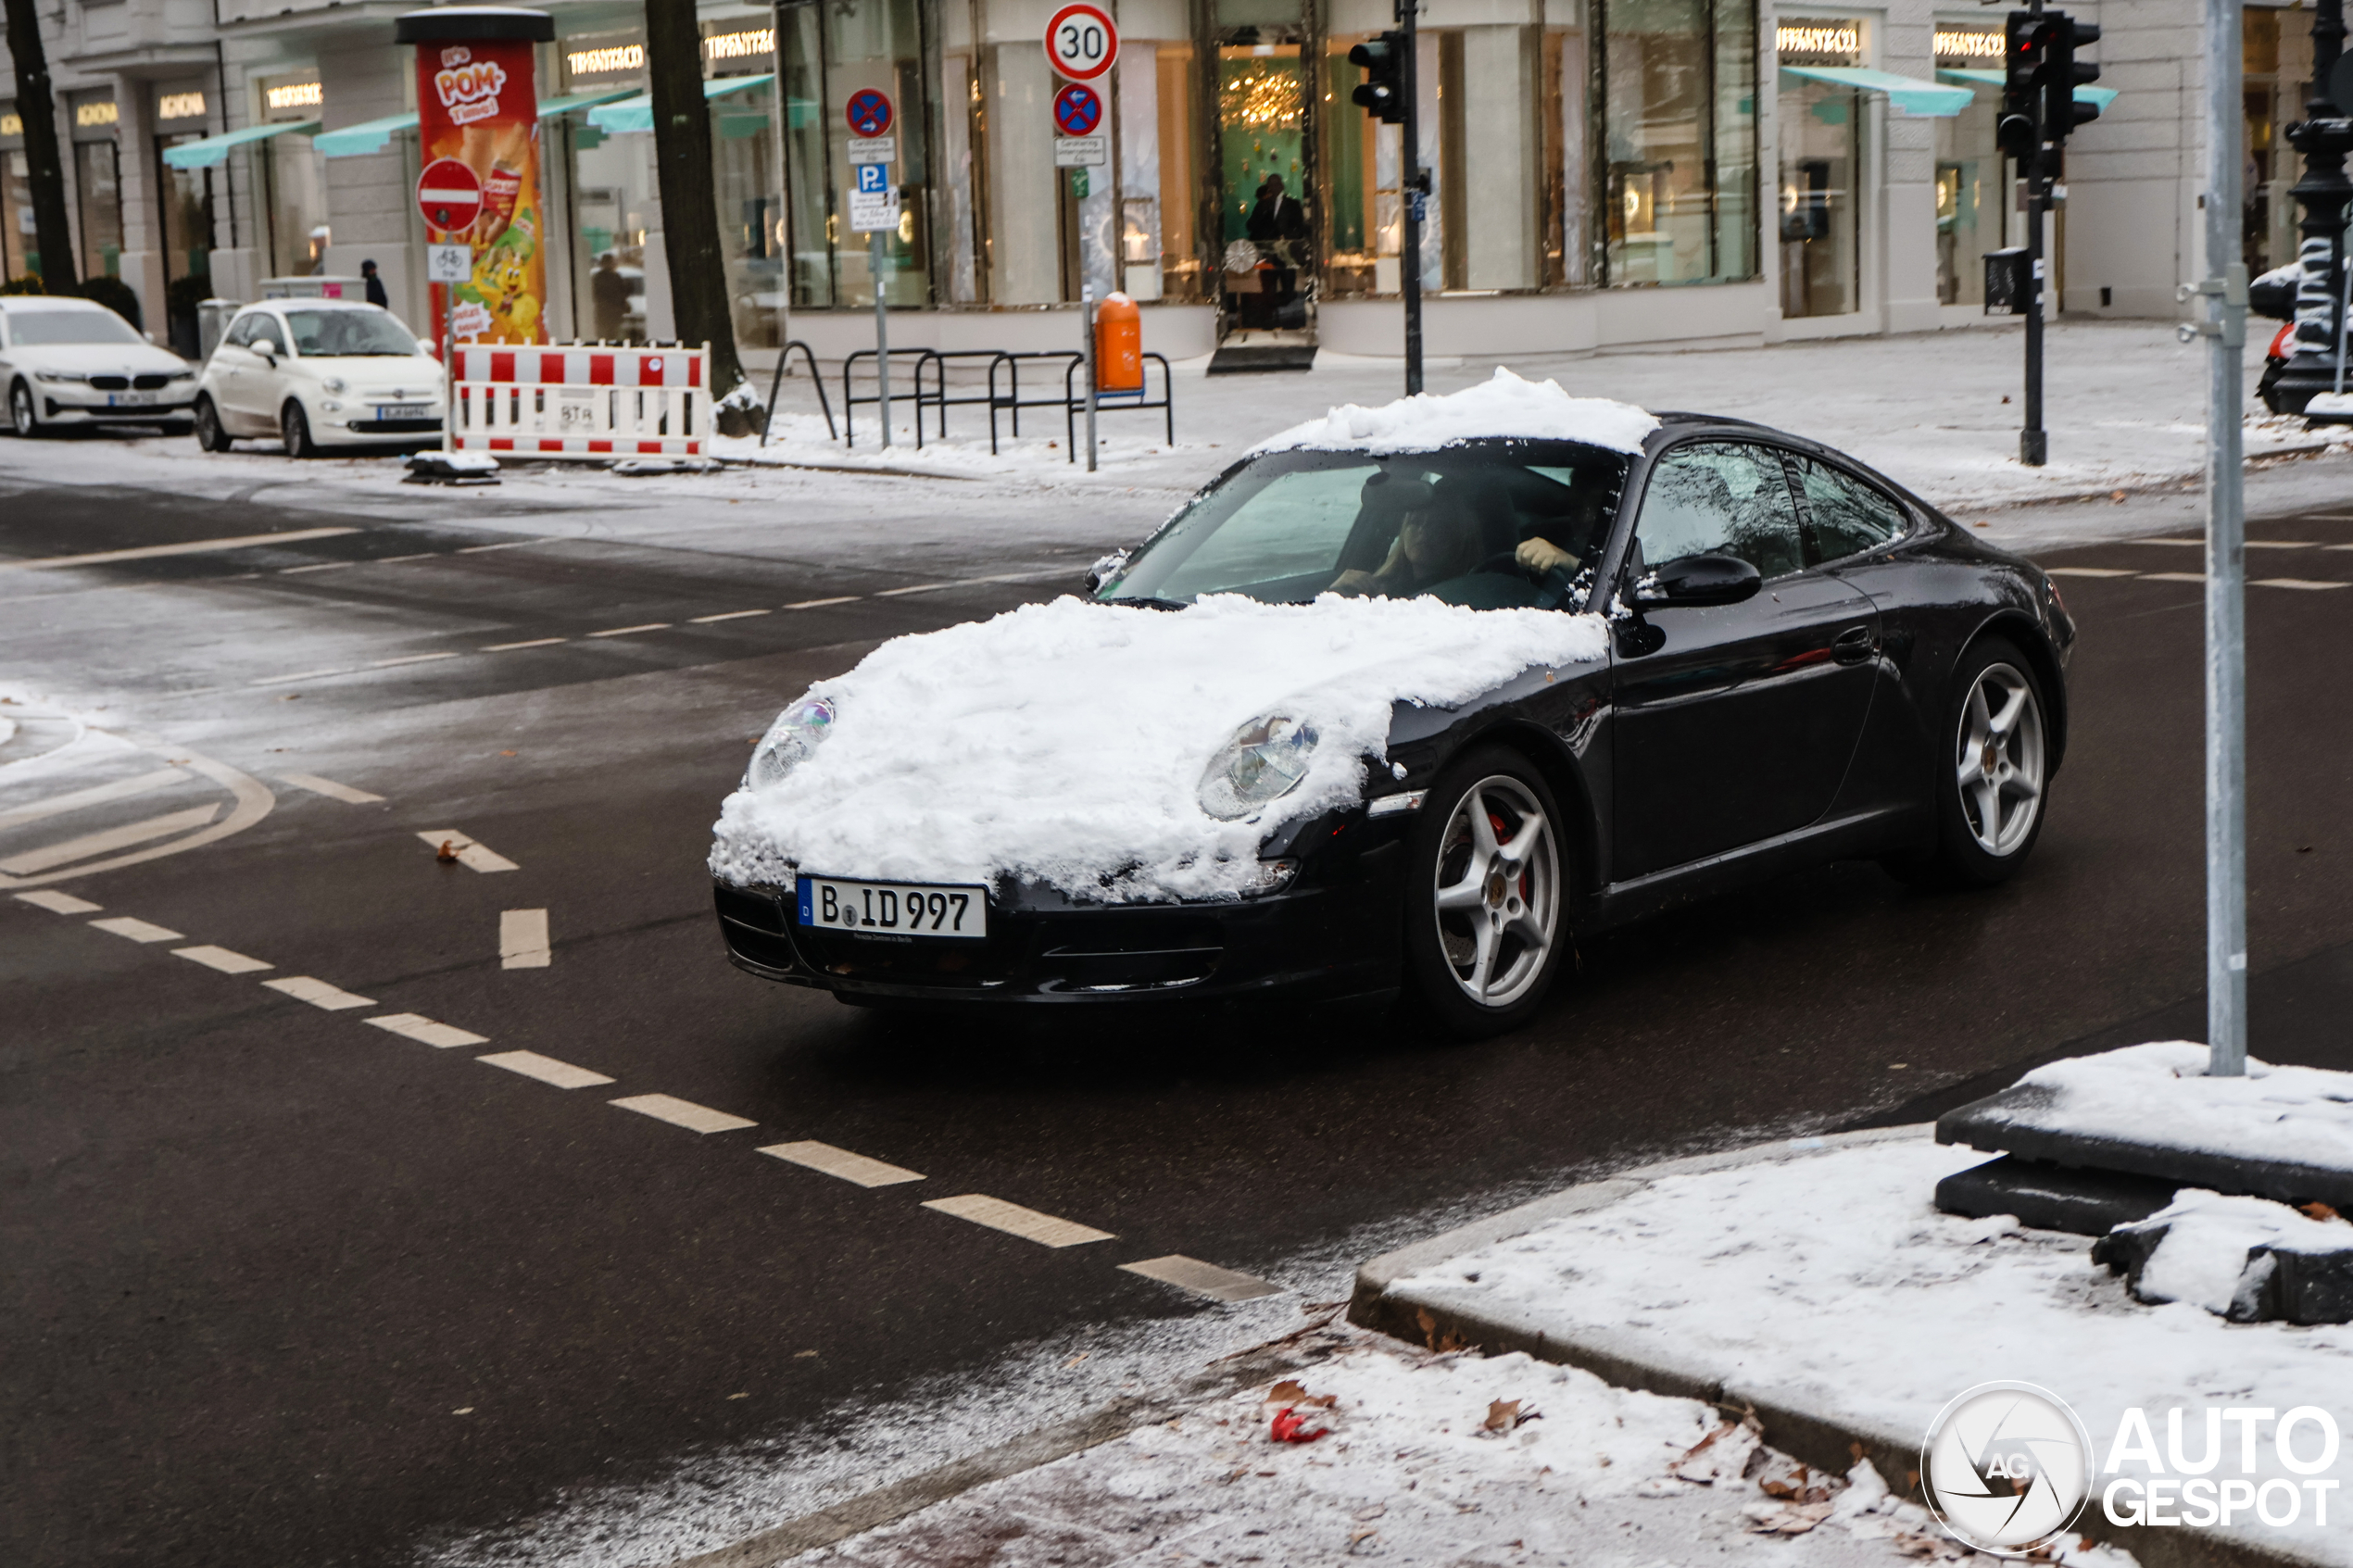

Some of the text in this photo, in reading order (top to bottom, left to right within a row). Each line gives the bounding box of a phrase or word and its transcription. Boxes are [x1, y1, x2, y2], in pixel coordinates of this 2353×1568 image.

[1062, 25, 1102, 59] 30
[436, 64, 505, 104] POM-
[862, 166, 879, 192] P
[802, 906, 810, 917] D
[822, 884, 969, 931] B ID 997
